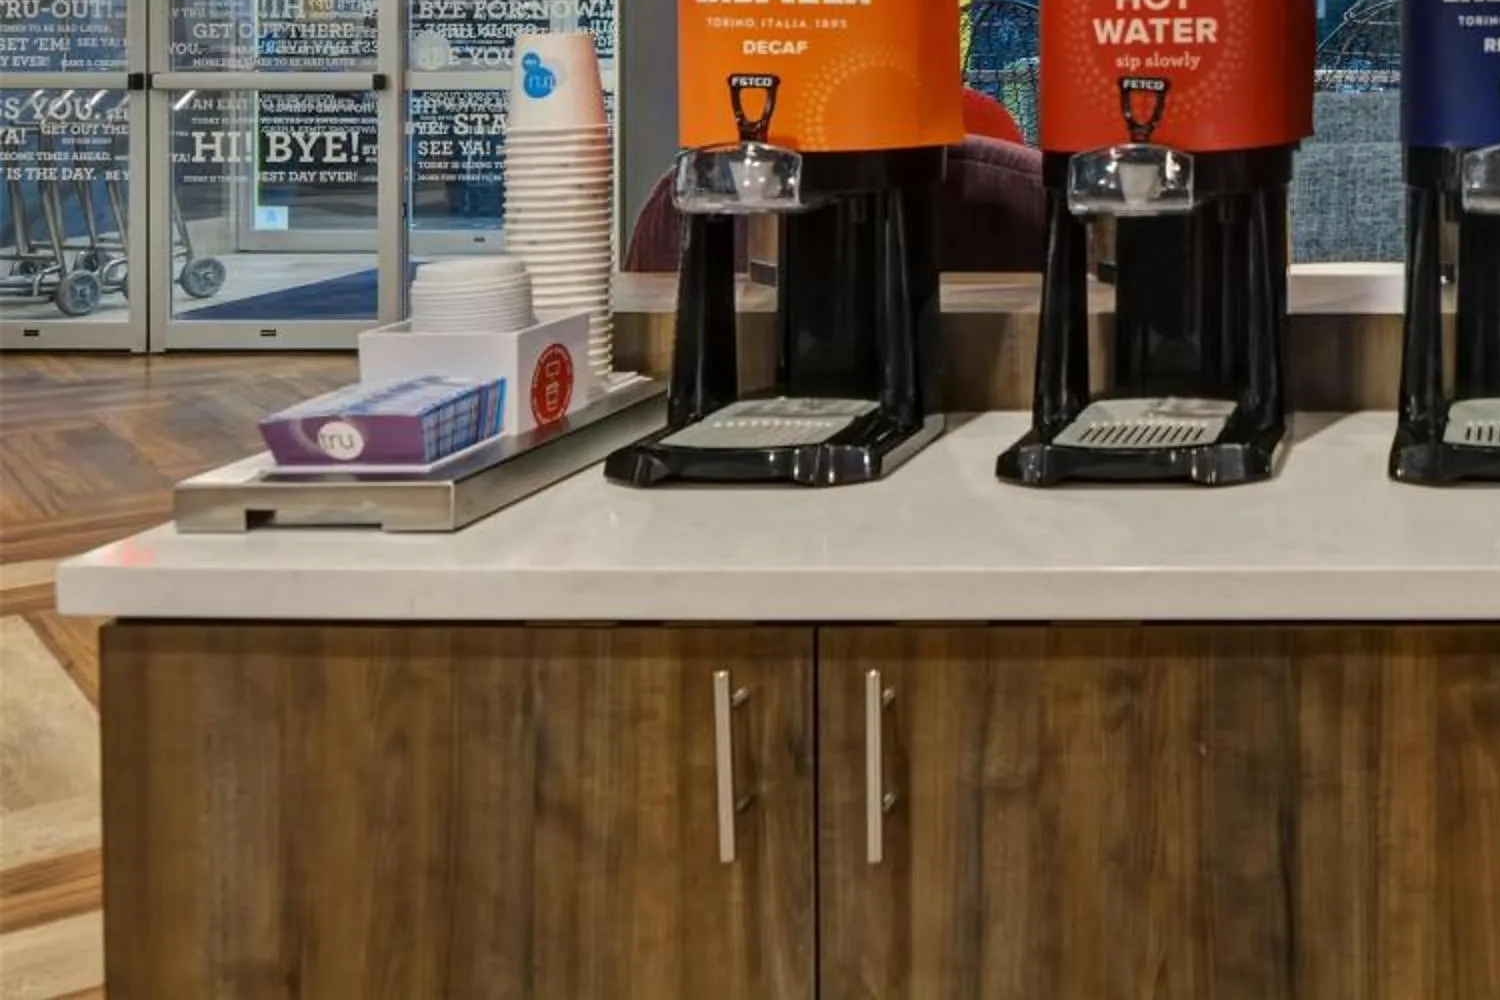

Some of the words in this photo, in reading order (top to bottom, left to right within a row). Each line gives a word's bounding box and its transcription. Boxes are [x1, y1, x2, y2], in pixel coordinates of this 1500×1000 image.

[0, 0, 113, 18] RU-OUT!
[419, 0, 467, 19] BYE
[193, 23, 234, 39] GET
[239, 23, 284, 39] OUT
[815, 19, 848, 29] 1895
[1093, 17, 1218, 44] WATER
[742, 40, 808, 55] DECAF
[1115, 54, 1142, 70] sip
[1145, 53, 1202, 71] slowly
[731, 76, 773, 88] FETCO
[1122, 78, 1165, 91] FETCO
[31, 96, 102, 121] YOU.
[453, 113, 509, 135] STA
[0, 128, 26, 146] A!
[191, 130, 253, 163] HI!
[265, 130, 360, 164] BYE!
[418, 141, 453, 156] SEE
[458, 140, 491, 156] YA!
[23, 167, 58, 181] THE
[289, 171, 318, 183] DAY
